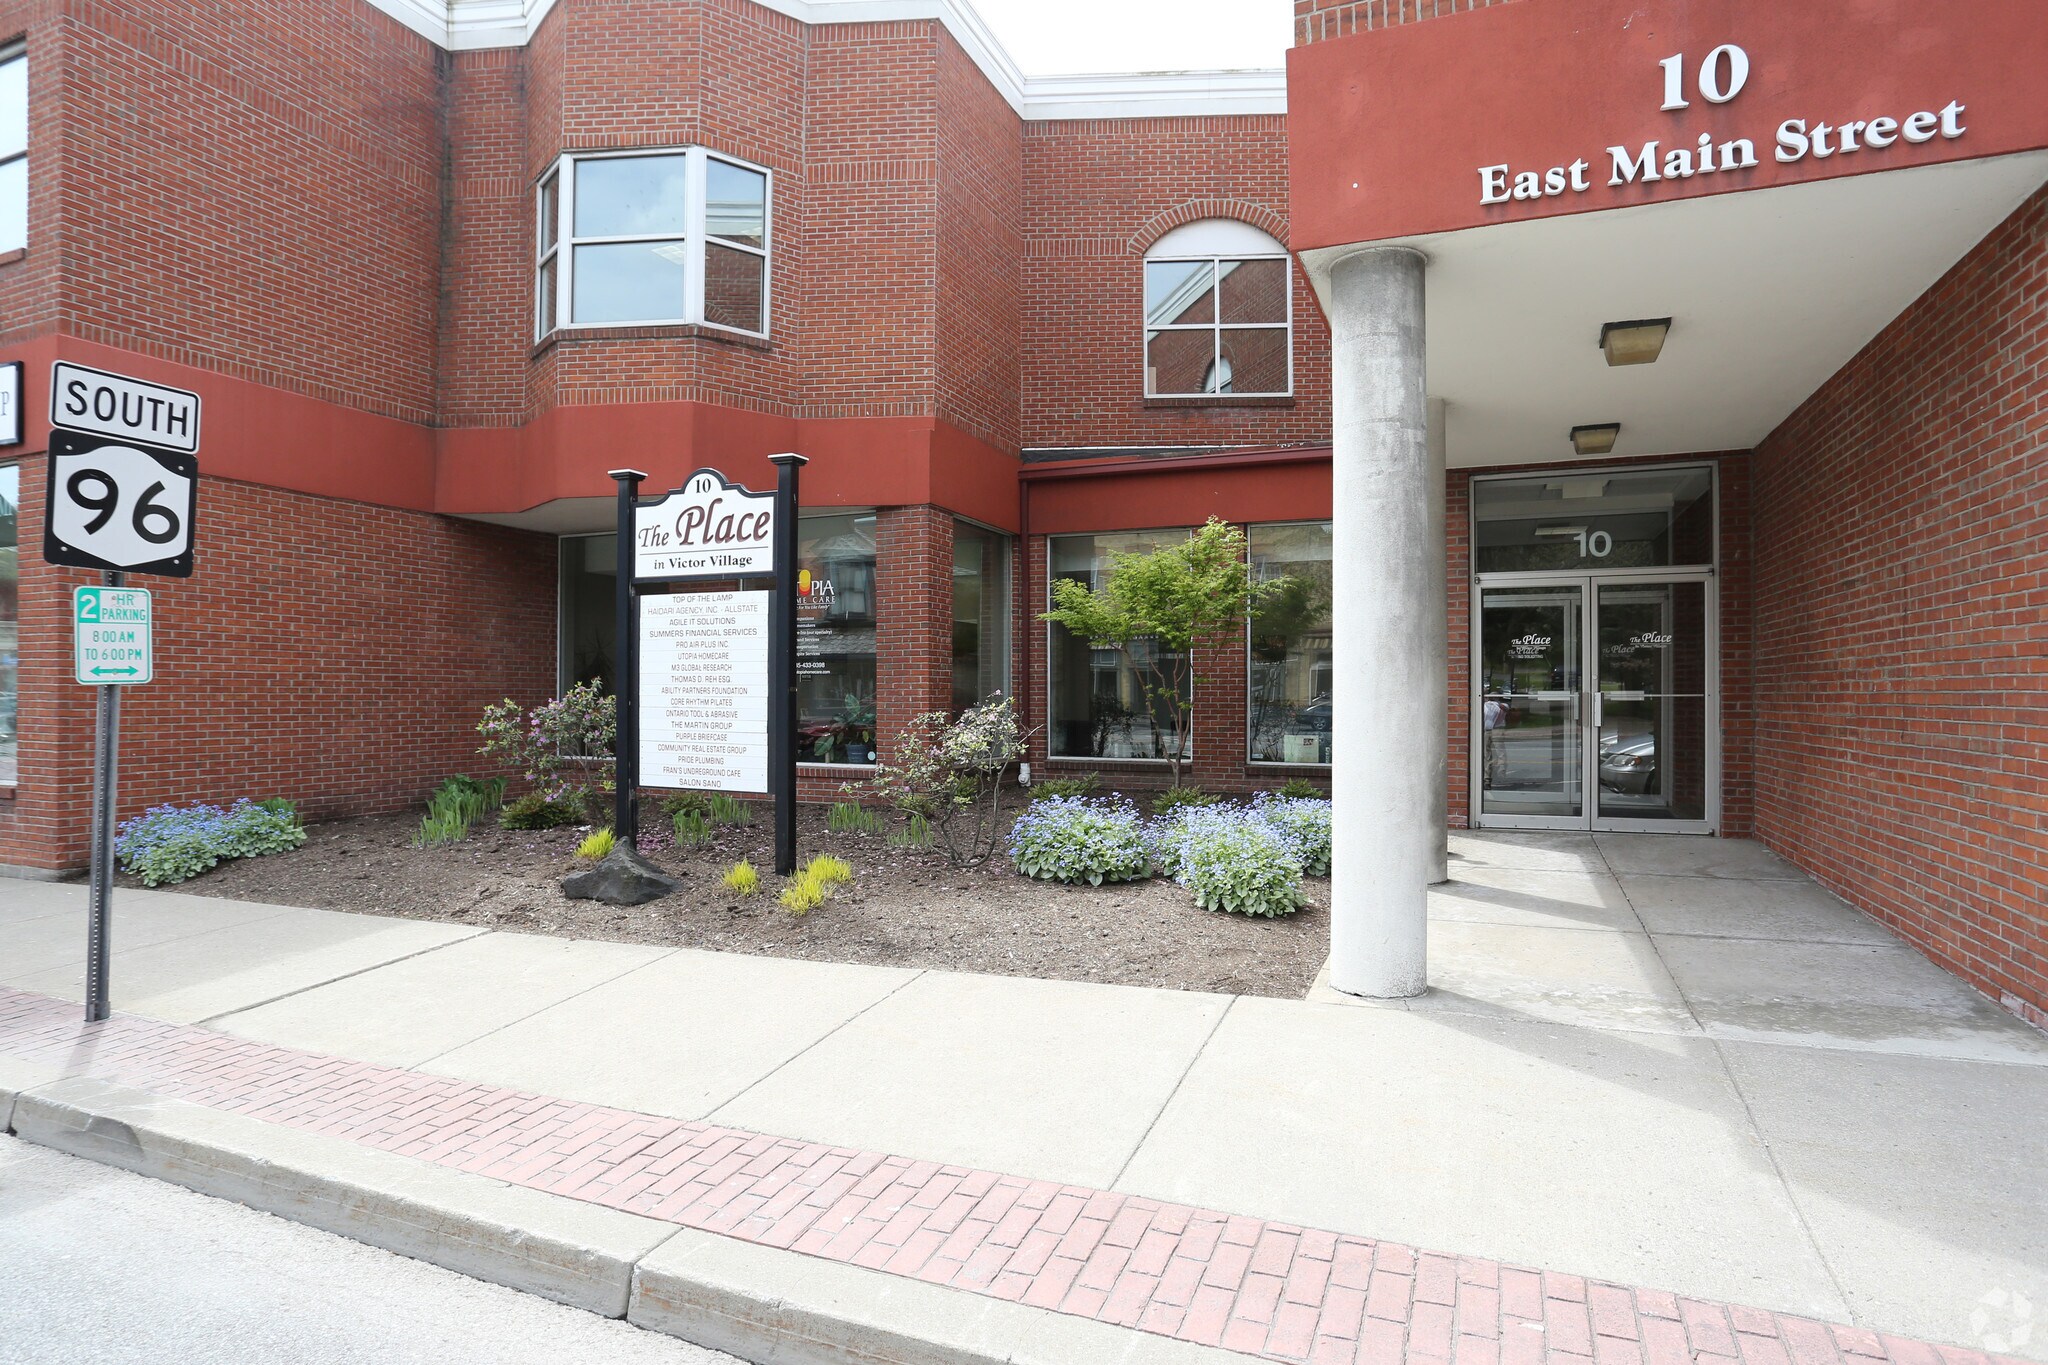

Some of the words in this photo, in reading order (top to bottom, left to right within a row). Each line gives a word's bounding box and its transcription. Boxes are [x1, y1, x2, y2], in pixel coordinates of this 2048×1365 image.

[1658, 43, 1750, 112] 10
[1478, 157, 1590, 206] East
[1606, 132, 1759, 187] Main
[1774, 100, 1967, 164] Street
[65, 379, 188, 438] SOUTH
[696, 478, 711, 494] 10
[66, 468, 181, 545] 96
[638, 525, 670, 548] The
[675, 497, 771, 546] Place
[1573, 530, 1612, 558] 10
[654, 560, 665, 569] in
[669, 558, 706, 569] Victor
[710, 555, 753, 568] Village
[672, 596, 685, 604] TOP
[687, 595, 694, 603] OF
[712, 594, 733, 602] LAMP
[812, 596, 836, 604] CARE
[80, 594, 97, 619] 2
[116, 594, 135, 606] HR
[648, 606, 674, 615] HAIDARI
[724, 605, 758, 613] ALLSTATE
[102, 608, 146, 620] PARKING
[689, 618, 696, 626] IT
[697, 617, 736, 626] SOLUTIONS
[93, 631, 116, 643] 800
[118, 631, 135, 643] AM
[649, 630, 684, 638] SUMMERS
[686, 629, 721, 637] FINANCIAL
[723, 628, 757, 636] SERVICES
[1641, 631, 1672, 642] Place
[1523, 633, 1551, 645] Place
[85, 648, 98, 660] TO
[102, 648, 125, 660] 600
[128, 649, 142, 660] PM
[698, 652, 729, 660] HOMECARE
[682, 687, 710, 695] PARTNERS
[711, 687, 748, 695] FOUNDATION
[670, 698, 685, 706] CORE
[686, 698, 709, 706] RHYTHM
[666, 710, 689, 718] ONTARIO
[690, 710, 704, 718] TOOL
[684, 721, 709, 729] MARTIN
[710, 722, 733, 730] GROUP
[676, 733, 696, 741] PURPLE
[698, 733, 728, 741] BRIEFCASE
[657, 744, 690, 752] COMMUNITY
[692, 745, 706, 753] REAL
[706, 745, 726, 754] ESTATE
[727, 746, 747, 754] GROUP
[678, 756, 694, 764] PRIDE
[695, 757, 724, 765] PLUMBING
[663, 766, 682, 774] FRAN'S
[726, 769, 741, 777] CAFE
[679, 778, 701, 786] SALON
